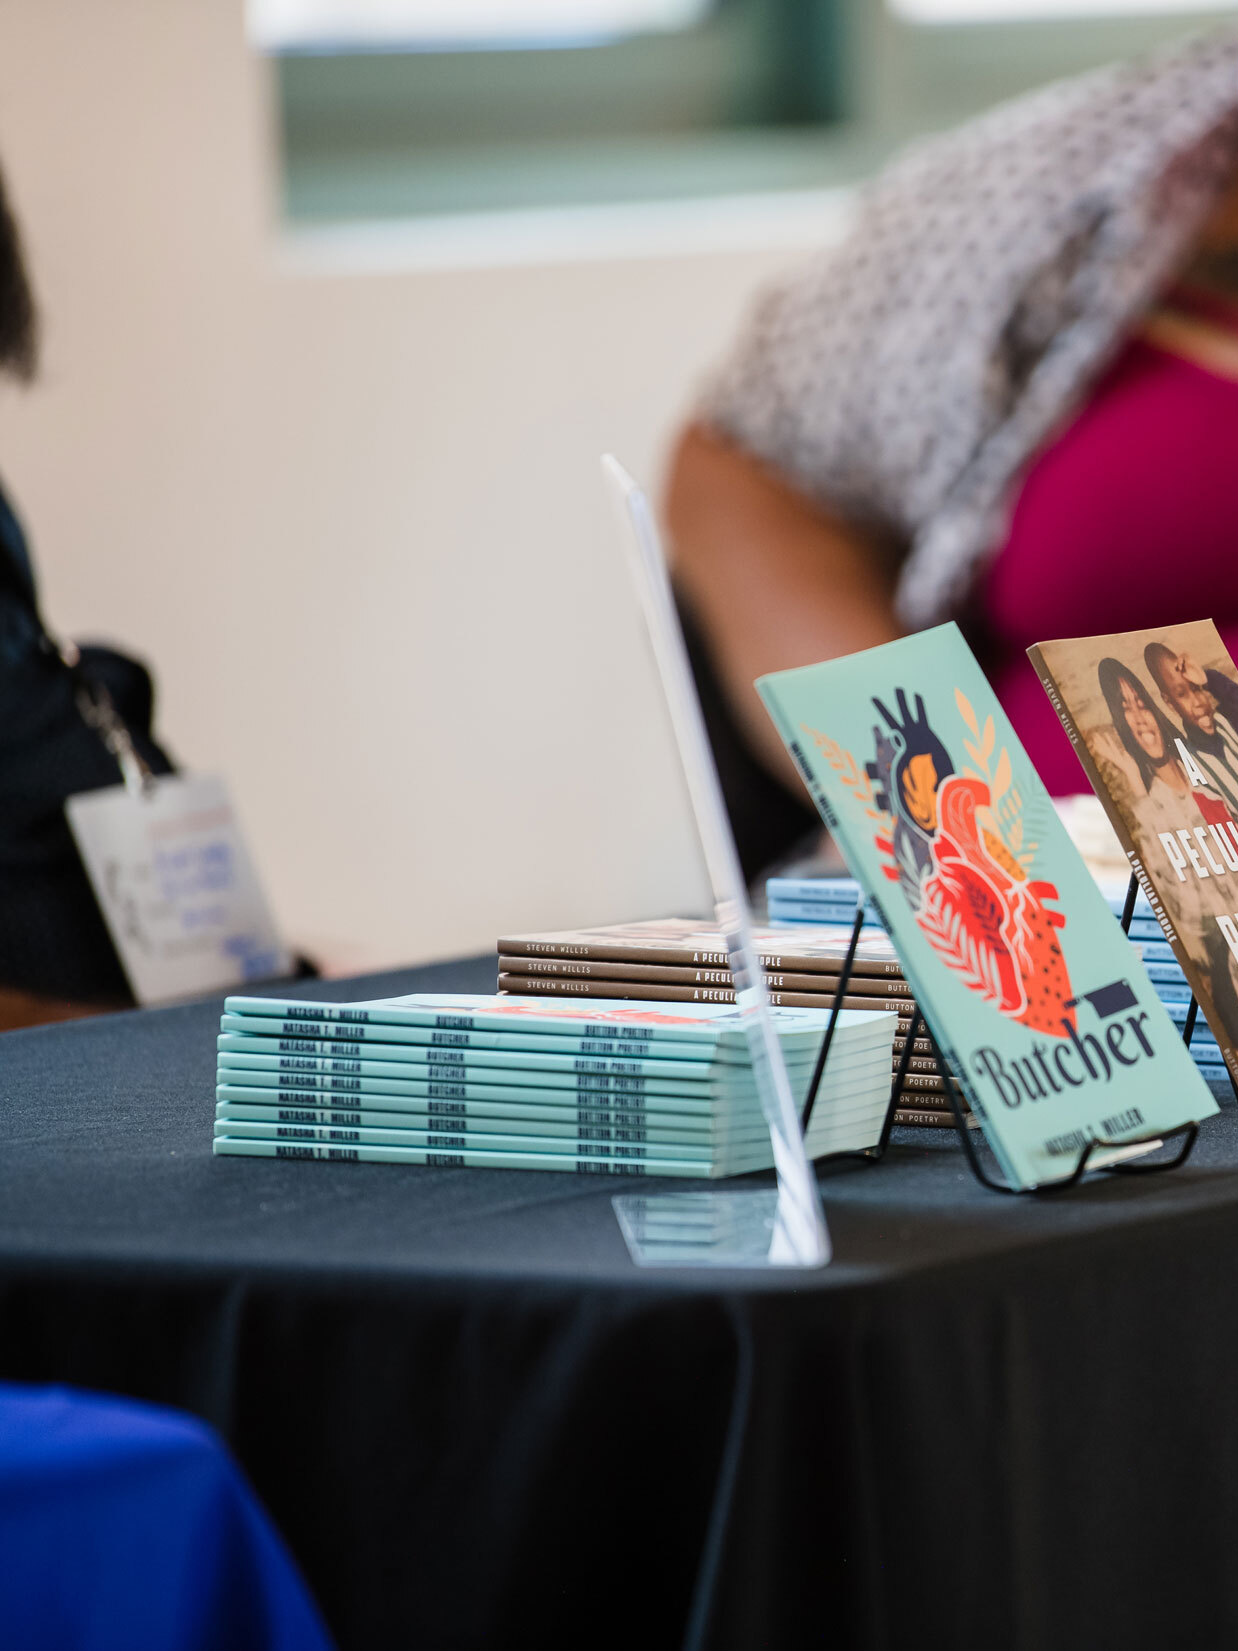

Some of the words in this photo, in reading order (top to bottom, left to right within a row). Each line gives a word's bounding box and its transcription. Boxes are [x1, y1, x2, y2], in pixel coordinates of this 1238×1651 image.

[1042, 678, 1061, 711] STEVEN
[1060, 711, 1079, 745] WILLIS
[1173, 738, 1208, 787] A
[1126, 850, 1134, 859] A
[1131, 859, 1159, 905] PECULIAR
[1154, 906, 1178, 943] PEOPLE
[526, 944, 555, 953] STEVEN
[560, 946, 589, 955] WILLIS
[693, 952, 699, 962] A
[702, 953, 729, 964] PECUL
[528, 963, 557, 972] STEVEN
[562, 965, 591, 974] WILLIS
[885, 965, 904, 973] BUTT
[695, 972, 701, 981] A
[704, 972, 735, 983] PECULI
[527, 981, 556, 990] STEVEN
[561, 983, 590, 992] WILLIS
[888, 984, 912, 992] BUTTO
[693, 990, 699, 999] A
[702, 990, 738, 1001] PECULIA
[885, 1003, 915, 1011] BUTTON
[287, 1007, 324, 1018] NATASHA
[339, 1010, 369, 1021] MILLER
[436, 1015, 474, 1028] BUTCHER
[283, 1023, 320, 1035] NATASHA
[335, 1026, 365, 1038] MILLER
[431, 1032, 470, 1045] BUTCHER
[279, 1040, 316, 1052] NATASHA
[330, 1043, 360, 1055] MILLER
[426, 1050, 464, 1062] BUTCHER
[970, 1011, 1154, 1109] Butcher
[280, 1058, 317, 1071] NATASHA
[331, 1060, 361, 1072] MILLER
[912, 1061, 937, 1069] POETR
[428, 1067, 466, 1079] BUTCHER
[279, 1075, 316, 1087] NATASHA
[331, 1078, 361, 1090] MILLER
[909, 1078, 939, 1086] POETRY
[428, 1084, 466, 1096] BUTCHER
[278, 1093, 316, 1104] NATASHA
[331, 1096, 361, 1107] MILLER
[915, 1096, 945, 1104] POETRY
[428, 1102, 467, 1114] BUTCHER
[278, 1110, 316, 1121] NATASHA
[331, 1113, 361, 1124] MILLER
[908, 1115, 939, 1123] POETRY
[428, 1119, 467, 1131] BUTCHER
[277, 1127, 315, 1138] NATASHA
[329, 1130, 360, 1141] MILLER
[427, 1135, 466, 1147] BUTCHER
[276, 1146, 314, 1157] NATASHA
[328, 1149, 359, 1160] MILLER
[426, 1153, 465, 1166] BUTCHER
